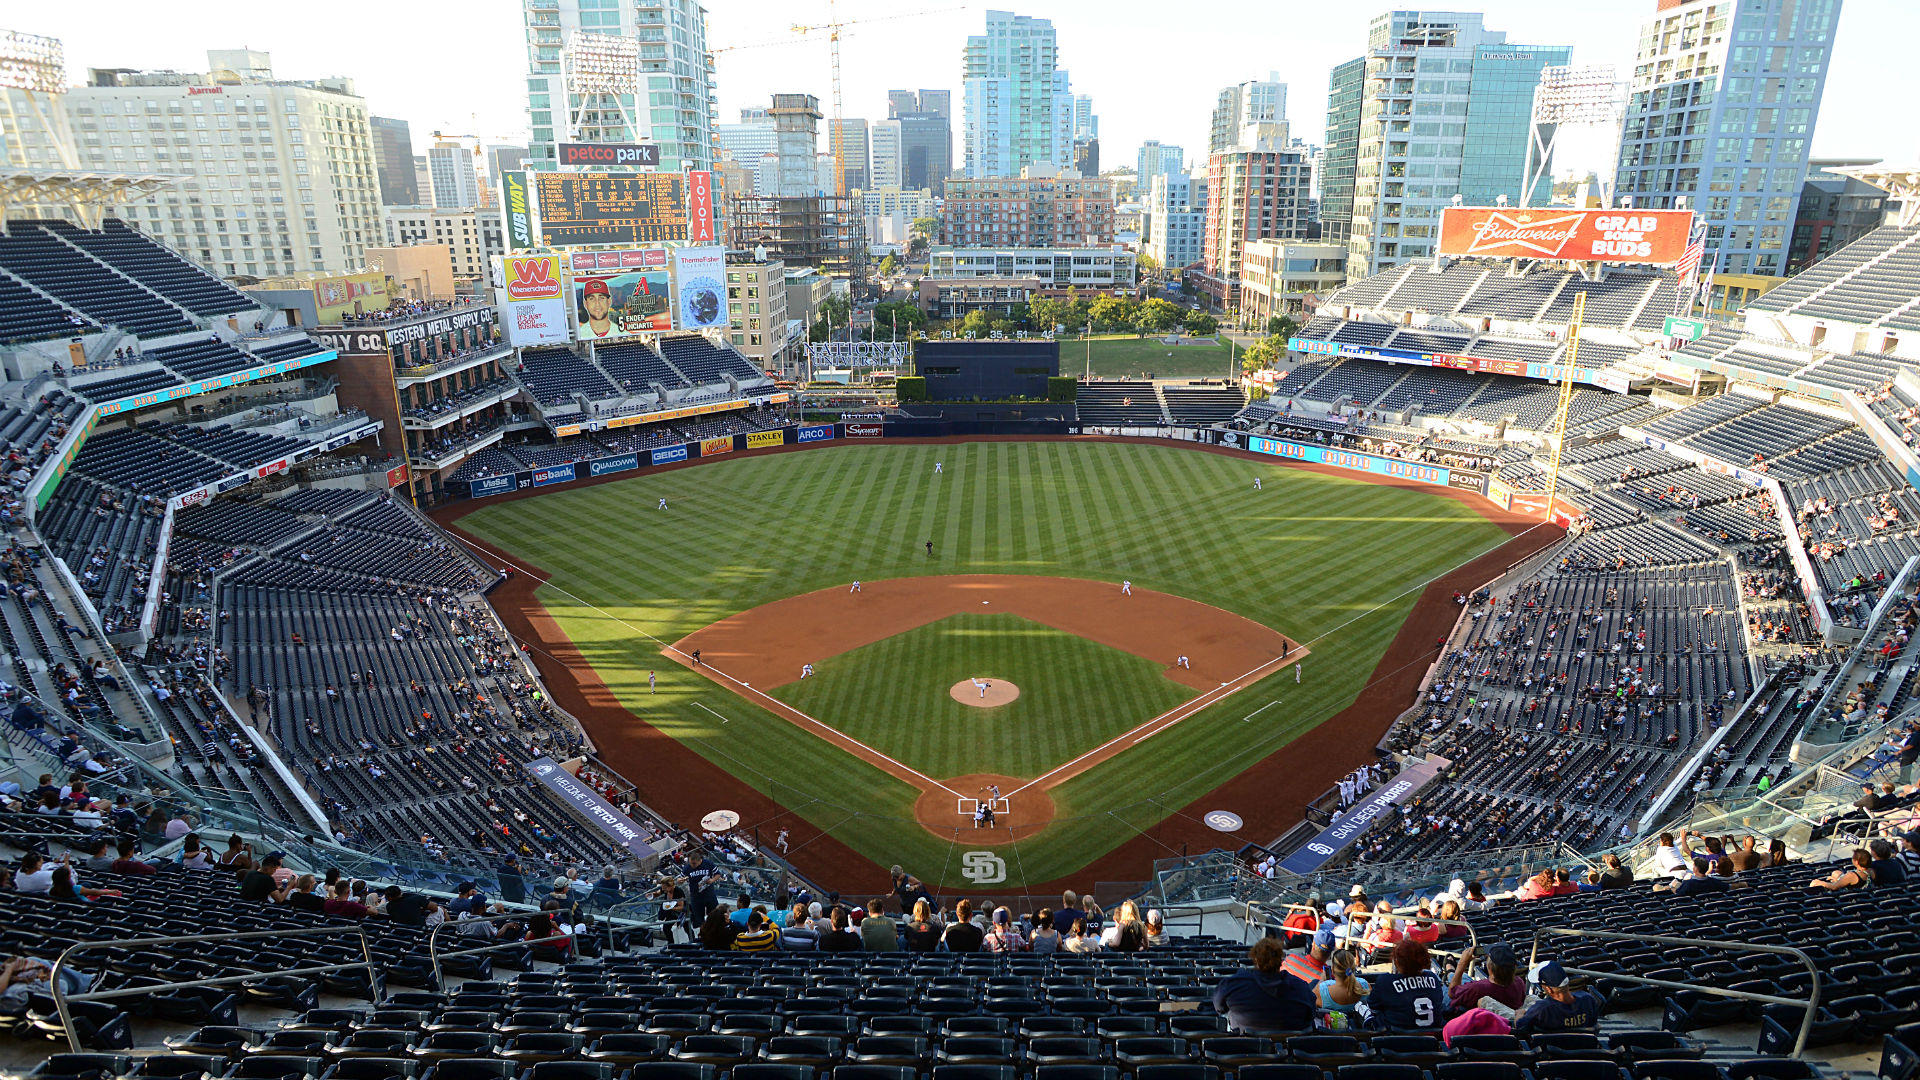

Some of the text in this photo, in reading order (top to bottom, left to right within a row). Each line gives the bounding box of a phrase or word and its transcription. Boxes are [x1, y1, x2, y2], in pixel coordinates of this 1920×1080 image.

[188, 86, 223, 96] Marriott
[567, 146, 652, 164] petco park
[507, 174, 530, 247] SUBWAY
[696, 174, 709, 239] TOYOTA
[1472, 220, 1577, 241] Budweiser
[1594, 216, 1658, 232] GRAB
[1602, 232, 1644, 242] SOME
[1592, 241, 1652, 257] BUDS
[512, 258, 552, 284] W
[386, 309, 492, 346] WESTERN METAL SUPPLY CO.
[618, 316, 625, 332] 5
[626, 322, 654, 330] INCIARTE
[358, 334, 387, 351] CO.
[920, 330, 1054, 339] 6 19 31 35 51 42
[803, 342, 914, 356] NATIONAL
[748, 432, 782, 442] STANLEY
[799, 430, 824, 439] ARCO
[654, 448, 686, 462] GEICO
[1258, 440, 1306, 459] LAS VEGAS
[592, 457, 636, 474] QUALCOMM
[1320, 450, 1371, 470] LAS VEGAS
[1385, 462, 1440, 482] LAS VEGAS
[482, 478, 508, 488] ViaSat
[519, 478, 531, 488] 357
[553, 775, 639, 841] WELCOME TO PETCO PARK
[1332, 780, 1413, 840] SAN DIEGO PADRES
[962, 850, 1007, 884] SD
[1392, 976, 1436, 994] GYORKO
[1414, 997, 1435, 1028] 9
